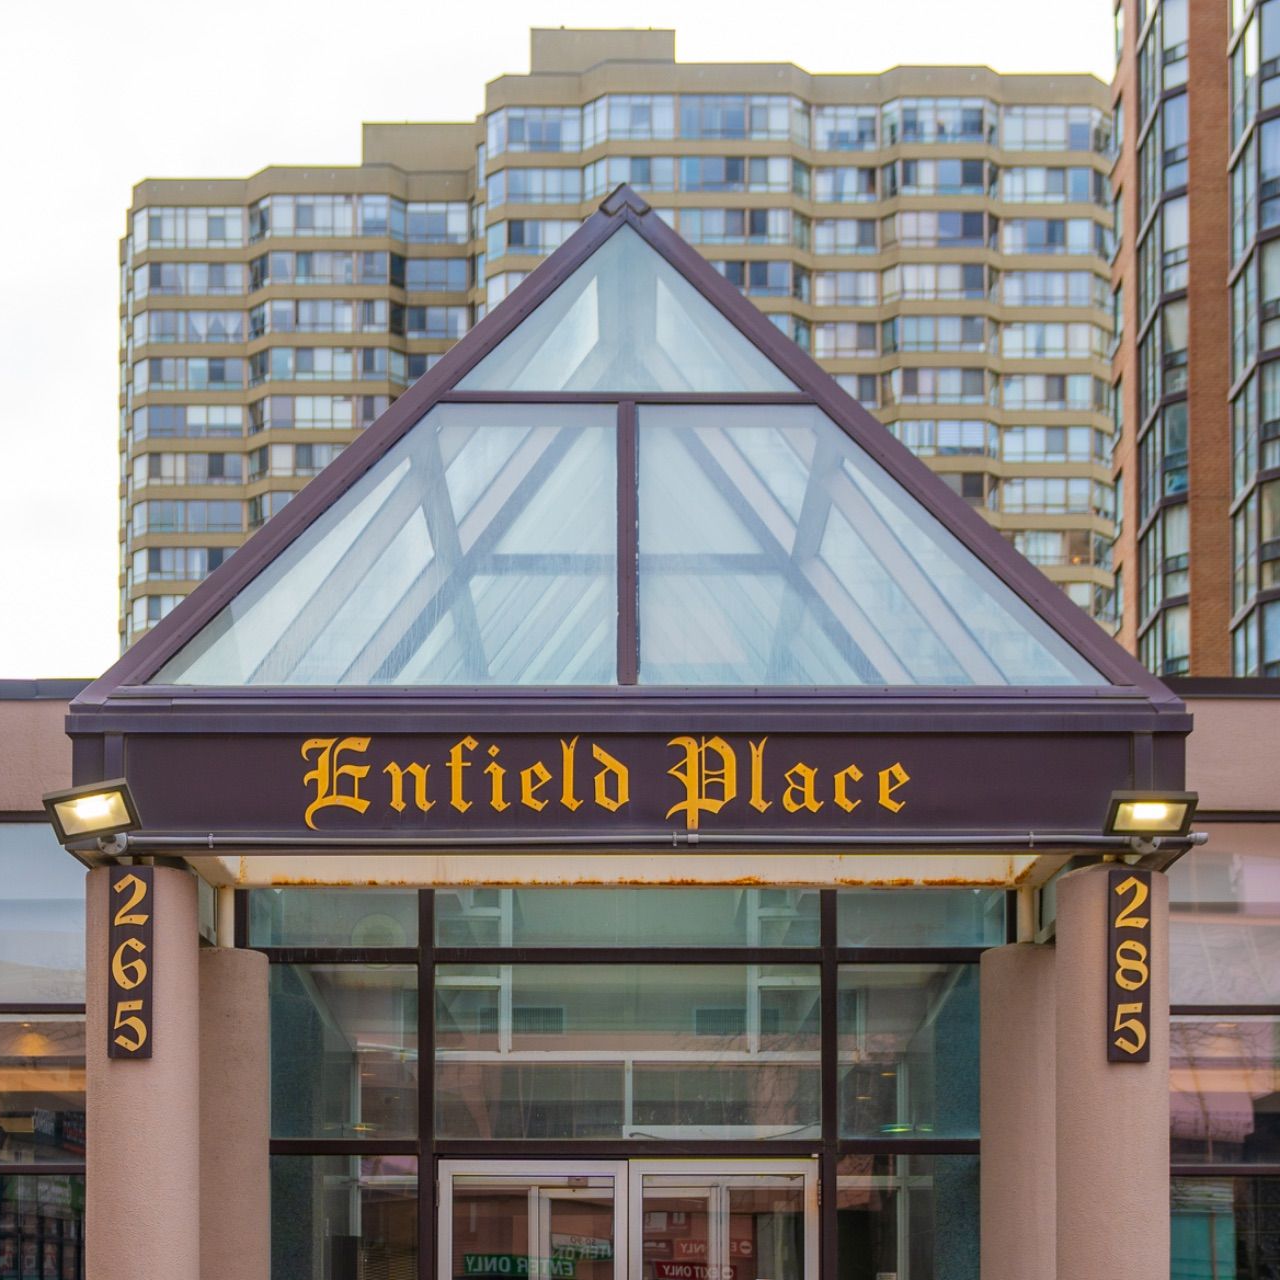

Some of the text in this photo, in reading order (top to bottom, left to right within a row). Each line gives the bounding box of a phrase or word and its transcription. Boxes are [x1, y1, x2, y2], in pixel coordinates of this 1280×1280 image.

[300, 735, 911, 831] Enfield Place
[111, 873, 148, 1052] 265
[1113, 876, 1150, 1054] 285
